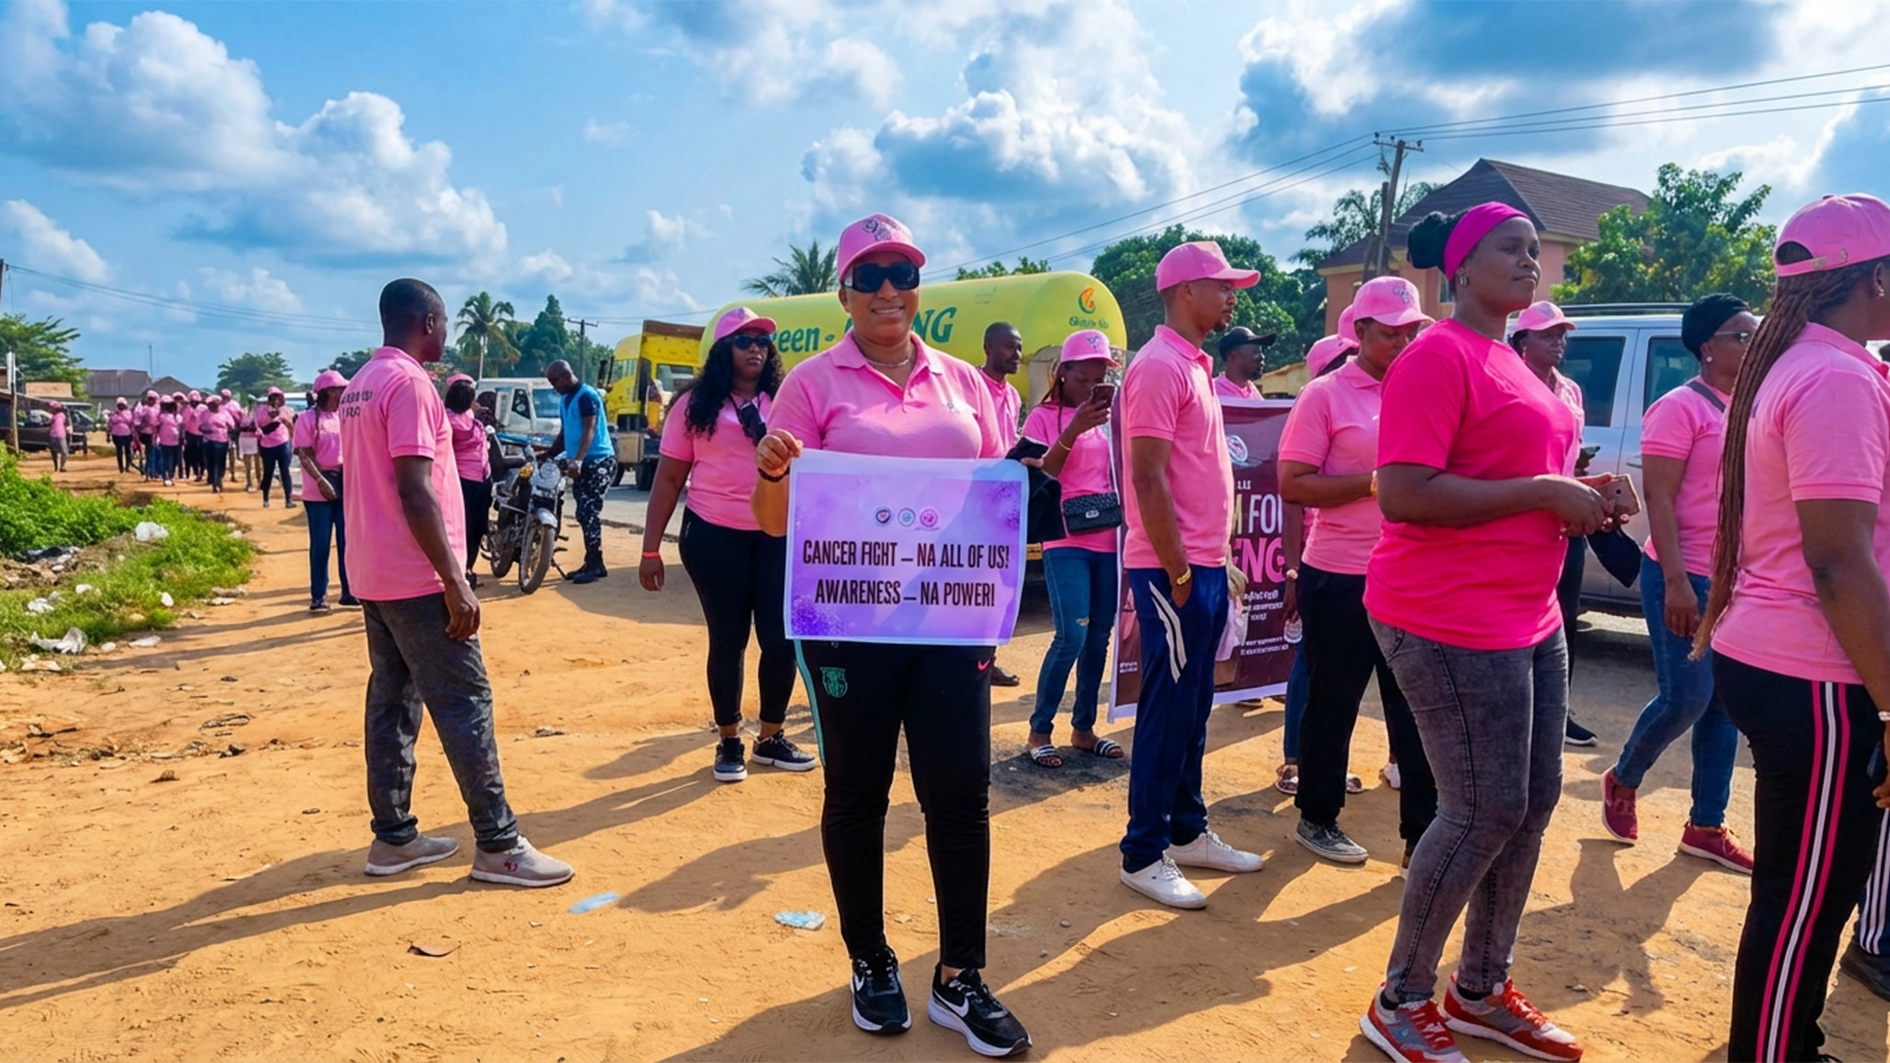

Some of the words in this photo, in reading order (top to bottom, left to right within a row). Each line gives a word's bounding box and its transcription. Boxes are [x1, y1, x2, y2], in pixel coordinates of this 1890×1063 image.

[773, 326, 821, 353] een
[803, 540, 857, 566] CANCER
[861, 541, 898, 567] FIGHT
[917, 543, 936, 567] NA
[940, 544, 964, 568] ALL
[968, 544, 984, 568] OF
[988, 545, 1010, 569] US!
[815, 579, 901, 604] AWARENESS
[920, 581, 939, 605] NA
[943, 582, 995, 607] POWER!
